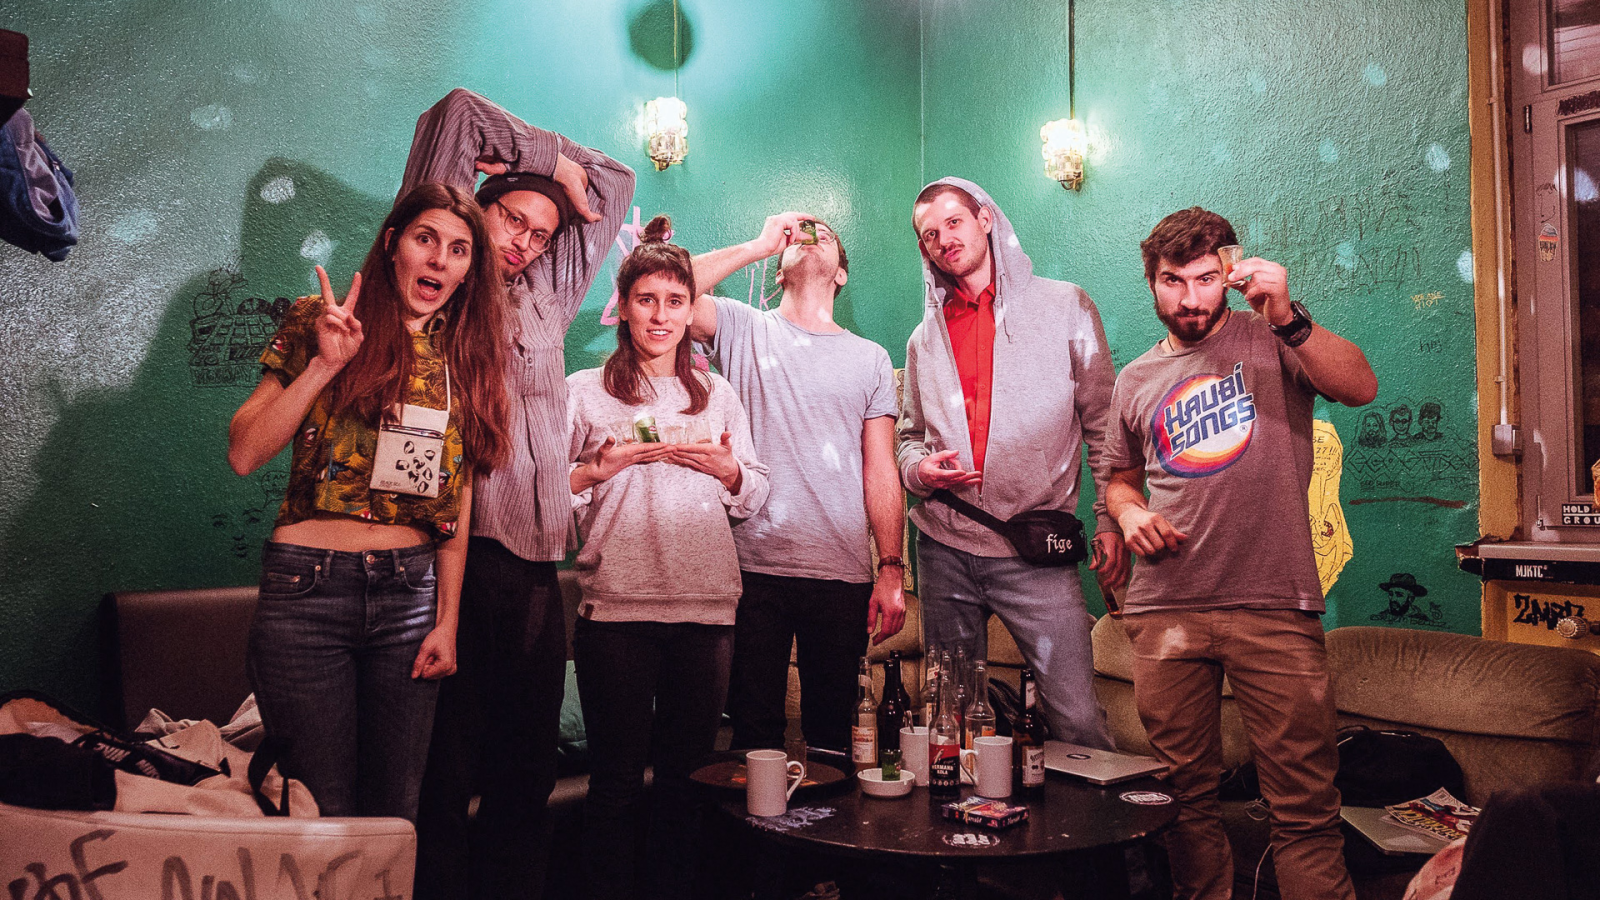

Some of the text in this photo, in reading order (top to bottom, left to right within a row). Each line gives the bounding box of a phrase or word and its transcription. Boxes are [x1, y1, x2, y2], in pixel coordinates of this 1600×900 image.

[1169, 393, 1256, 461] SONGS
[1563, 505, 1590, 513] HOLD
[1563, 516, 1600, 525] GROU
